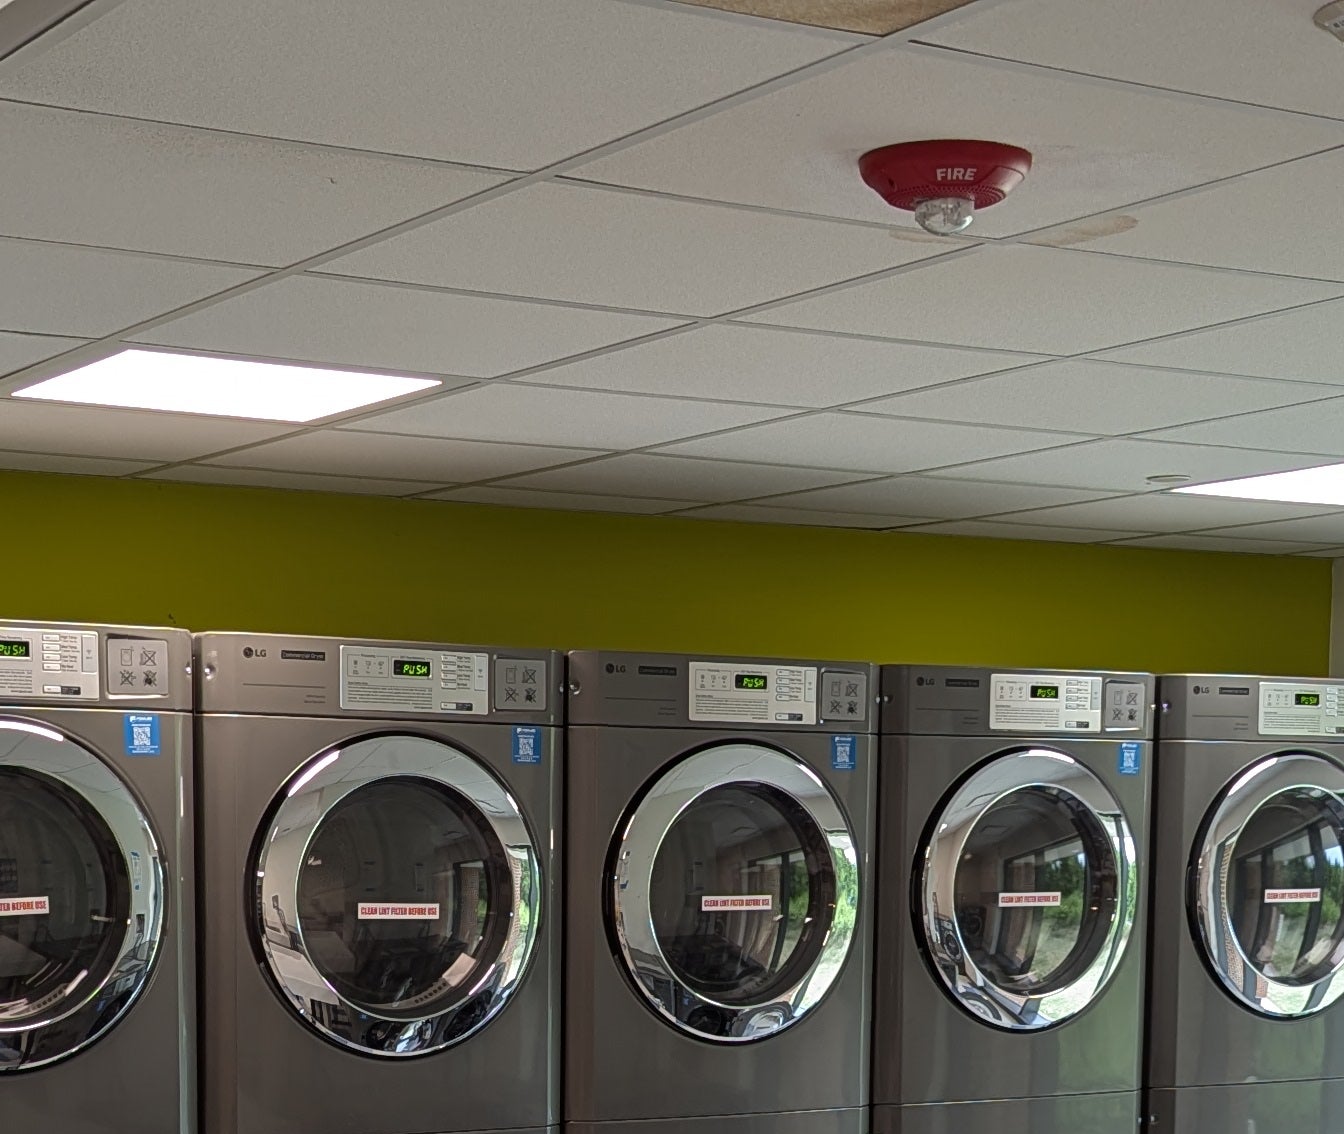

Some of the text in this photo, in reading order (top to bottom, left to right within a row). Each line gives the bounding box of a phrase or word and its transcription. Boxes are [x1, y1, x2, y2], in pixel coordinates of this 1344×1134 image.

[936, 168, 977, 181] FIRE
[255, 649, 267, 658] LG
[403, 664, 428, 675] PUSH
[616, 665, 626, 673] LG
[12, 901, 34, 911] BEFORE
[35, 901, 47, 910] USE
